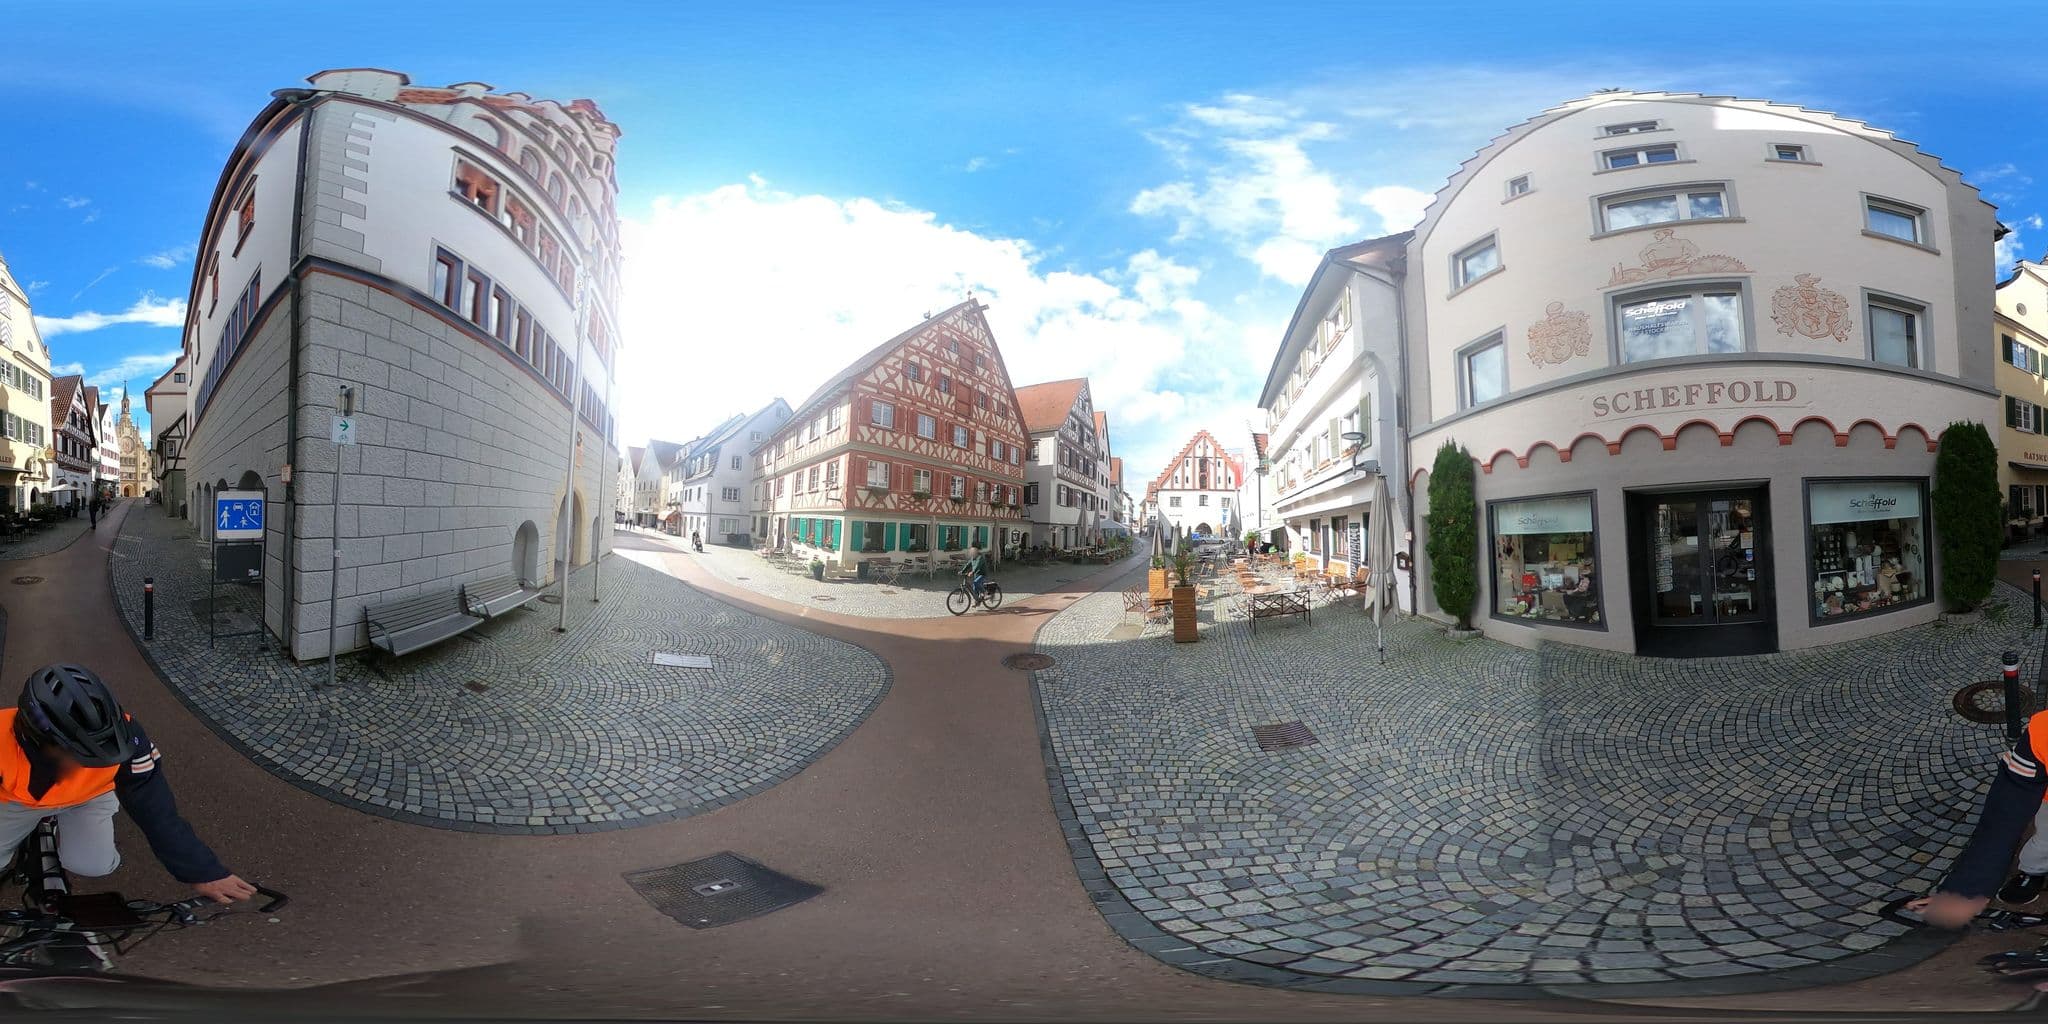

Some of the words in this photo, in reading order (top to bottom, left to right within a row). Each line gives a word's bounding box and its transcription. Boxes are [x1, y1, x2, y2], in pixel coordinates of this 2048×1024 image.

[1625, 302, 1686, 317] Scheffold
[1592, 380, 1798, 418] SCHEFFOLD
[1849, 497, 1897, 509] Scheffold
